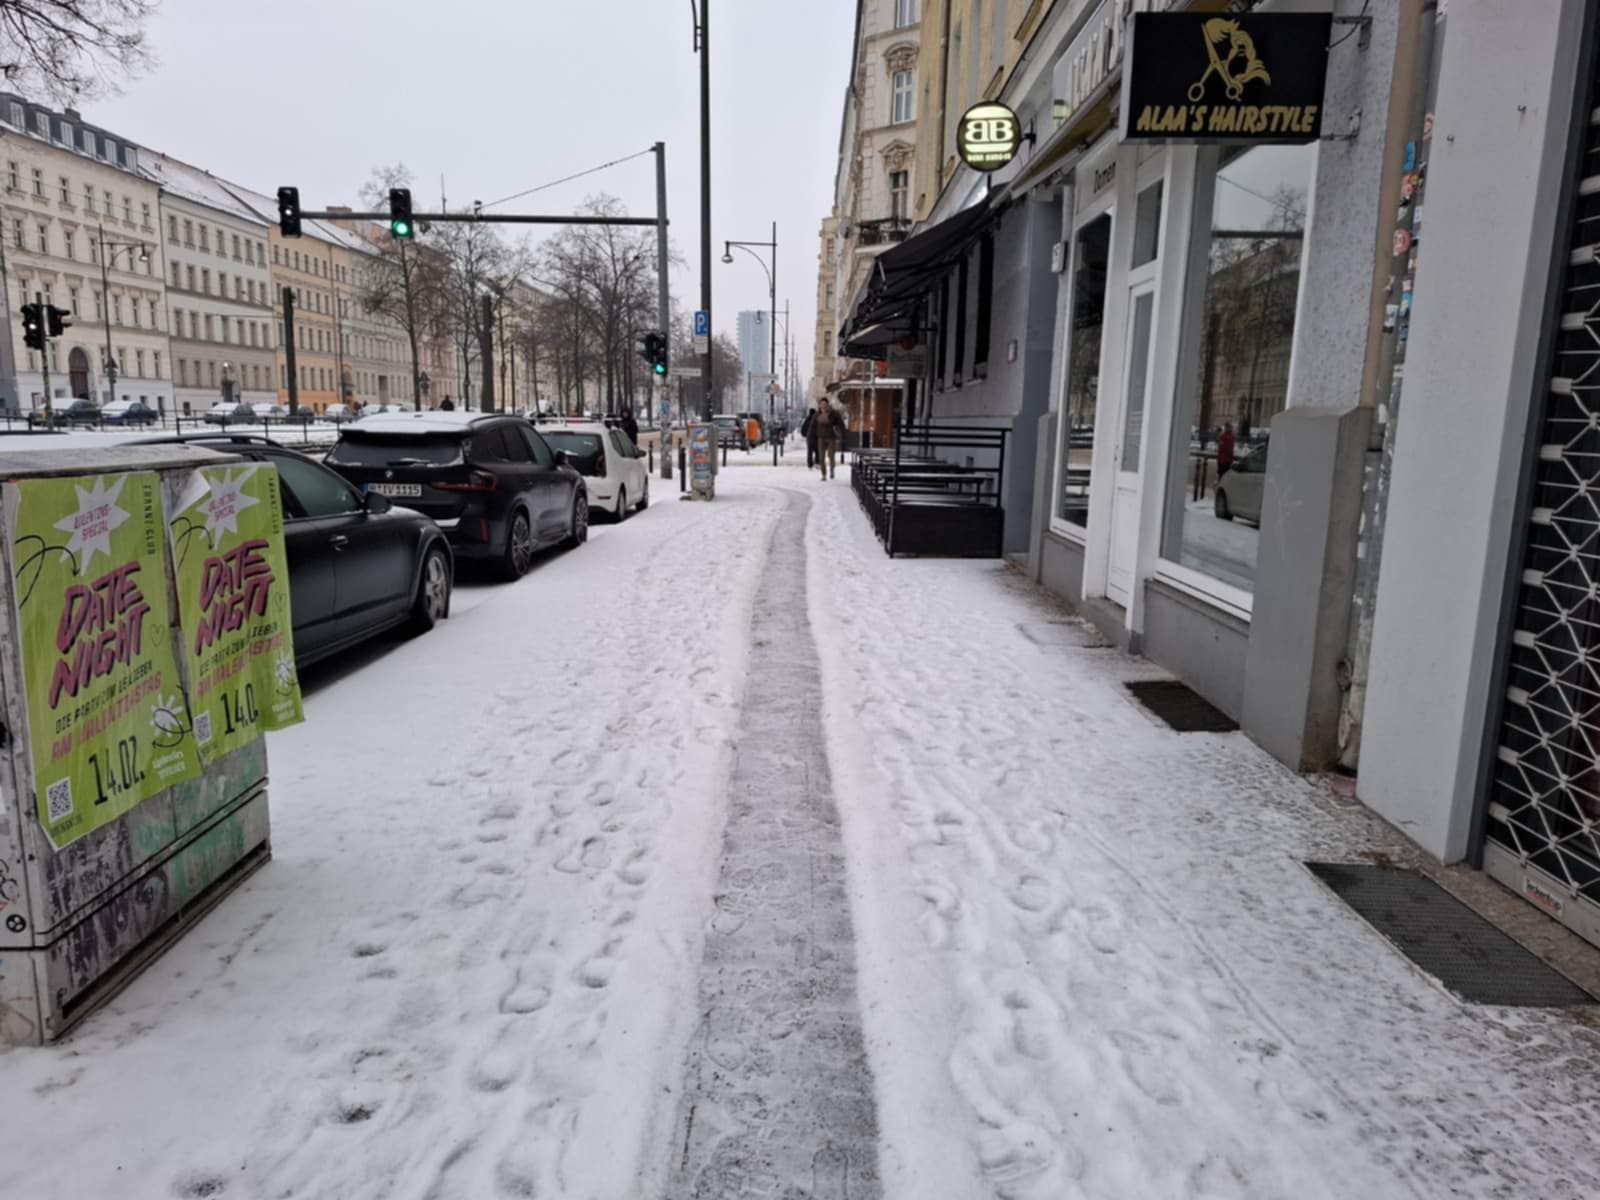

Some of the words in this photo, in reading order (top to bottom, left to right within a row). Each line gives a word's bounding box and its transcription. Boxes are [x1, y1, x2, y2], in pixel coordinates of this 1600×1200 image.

[1136, 105, 1207, 132] ALAA'S
[1208, 105, 1317, 133] HAIRSTYLE
[697, 314, 705, 333] P
[56, 561, 144, 654] DATE
[200, 539, 271, 612] DATE
[49, 602, 151, 709] NIGHT
[56, 713, 71, 734] DIE
[89, 736, 146, 806] 14.02.
